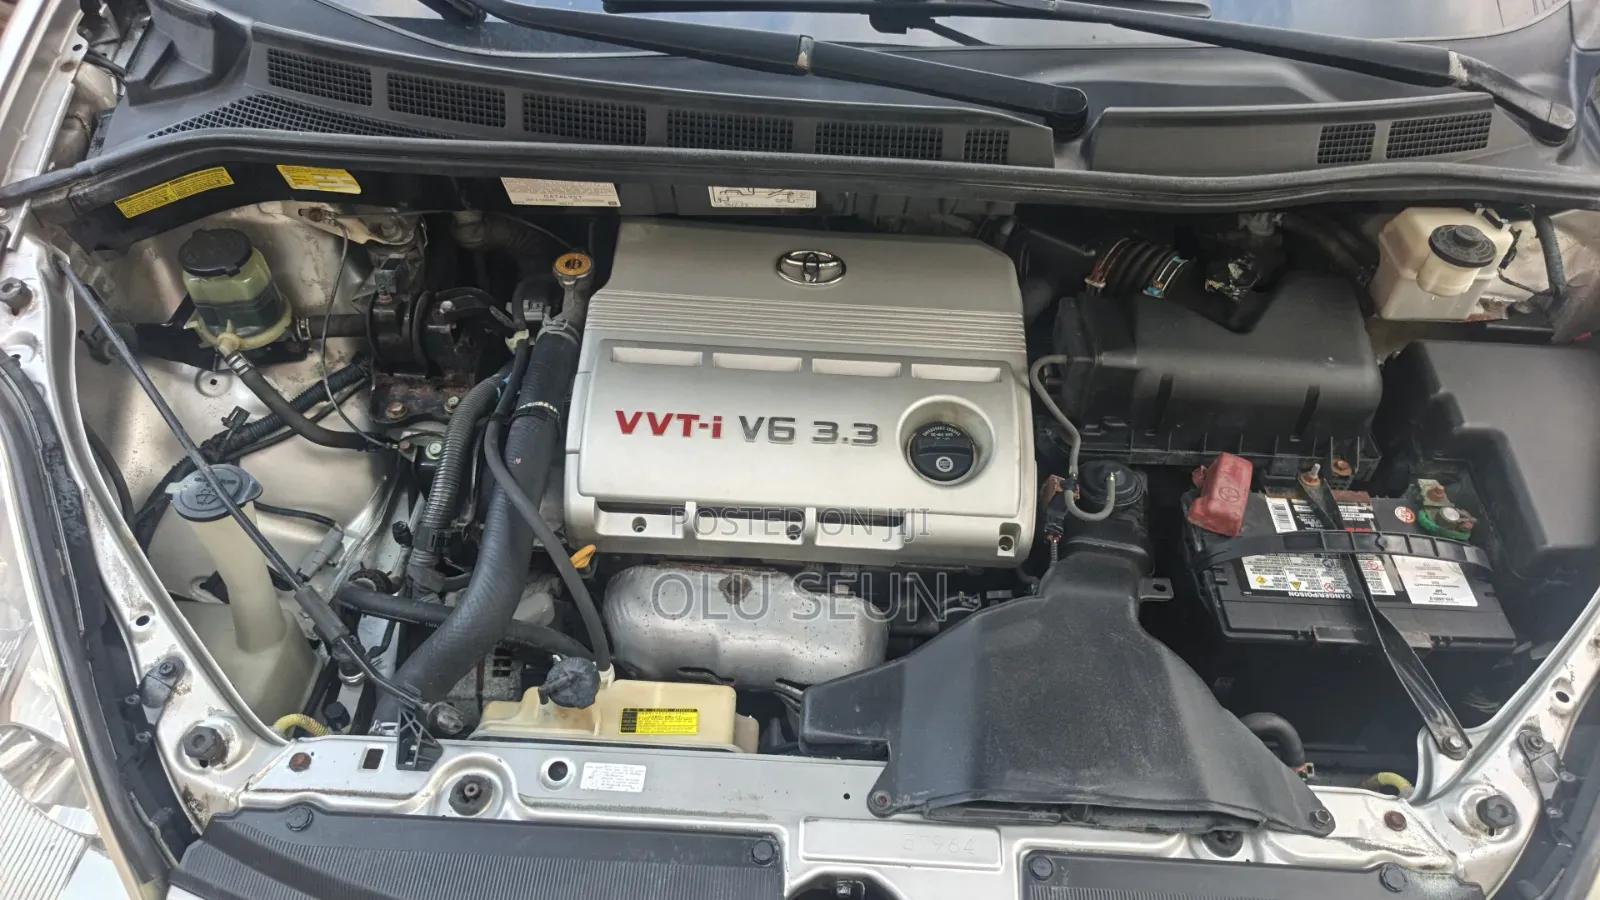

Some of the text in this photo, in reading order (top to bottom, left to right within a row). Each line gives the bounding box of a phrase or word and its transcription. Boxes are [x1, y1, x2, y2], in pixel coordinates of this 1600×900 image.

[615, 410, 880, 447] VVT-i V6 3.3
[1288, 591, 1352, 600] DANGER/POISON
